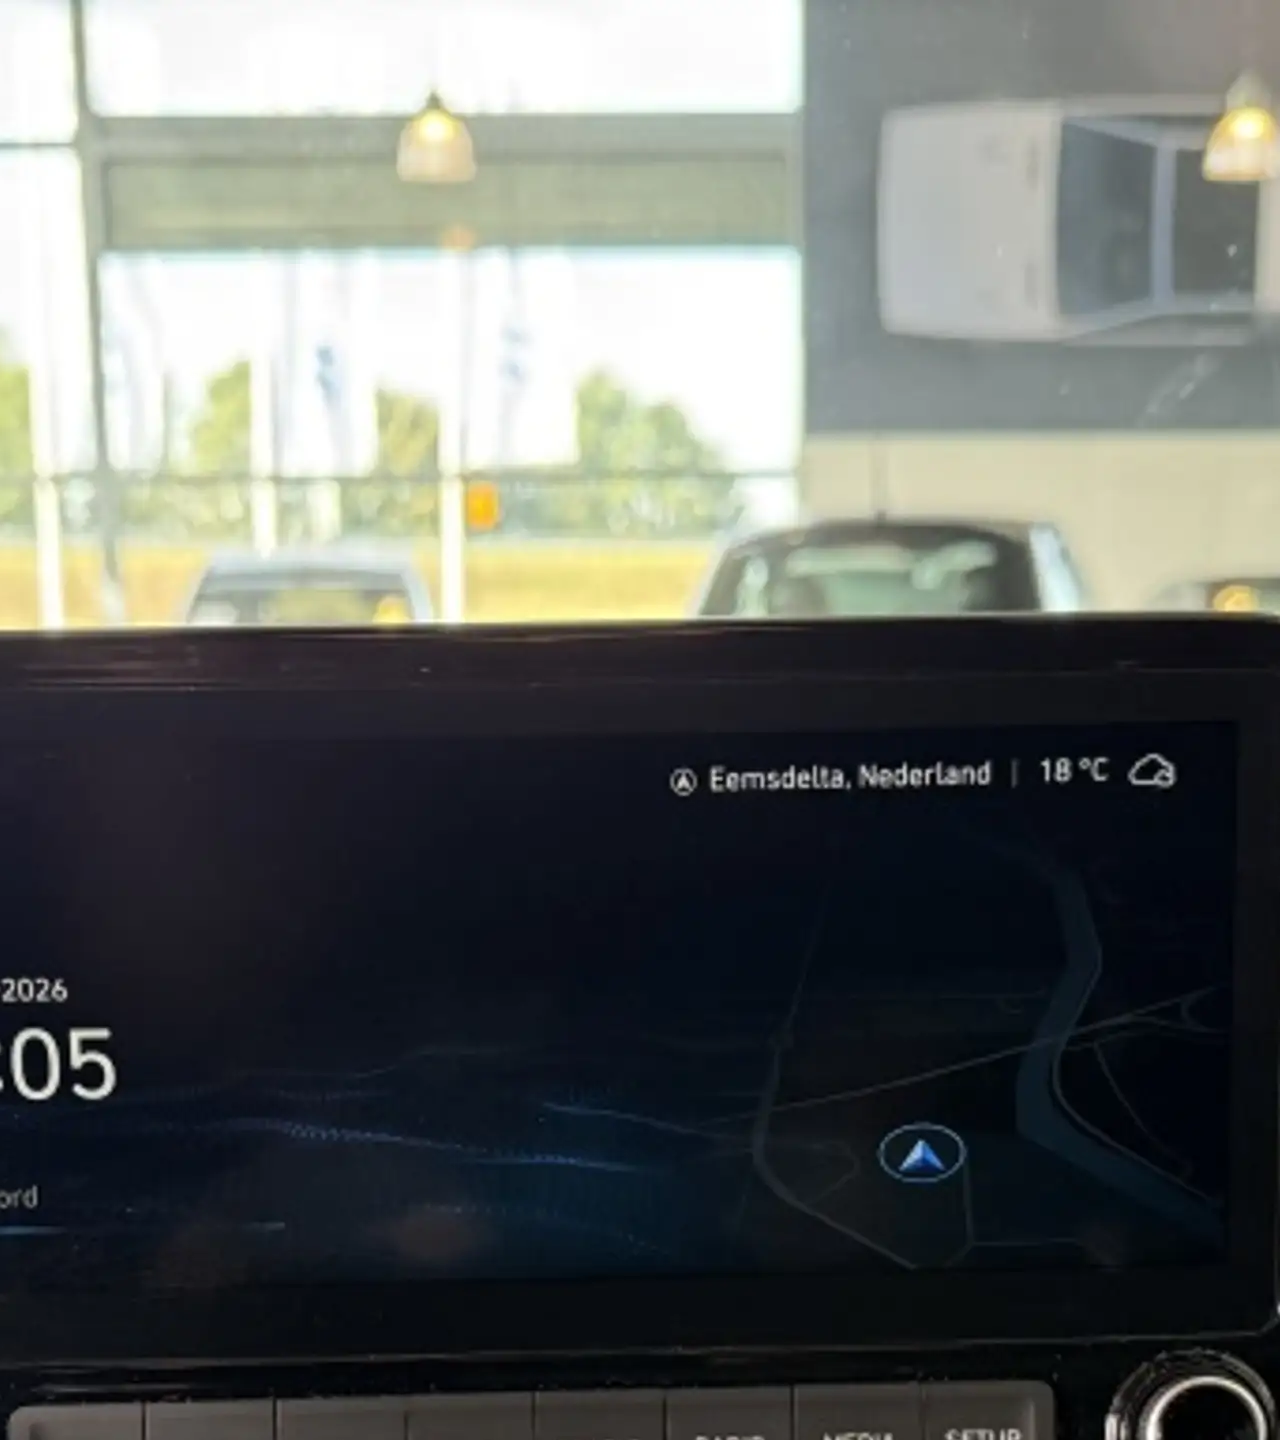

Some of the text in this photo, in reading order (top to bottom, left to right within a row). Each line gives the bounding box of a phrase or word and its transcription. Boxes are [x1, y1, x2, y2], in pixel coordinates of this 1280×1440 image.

[710, 761, 991, 792] Eemsdelta, Nederland
[1041, 757, 1072, 783] 18
